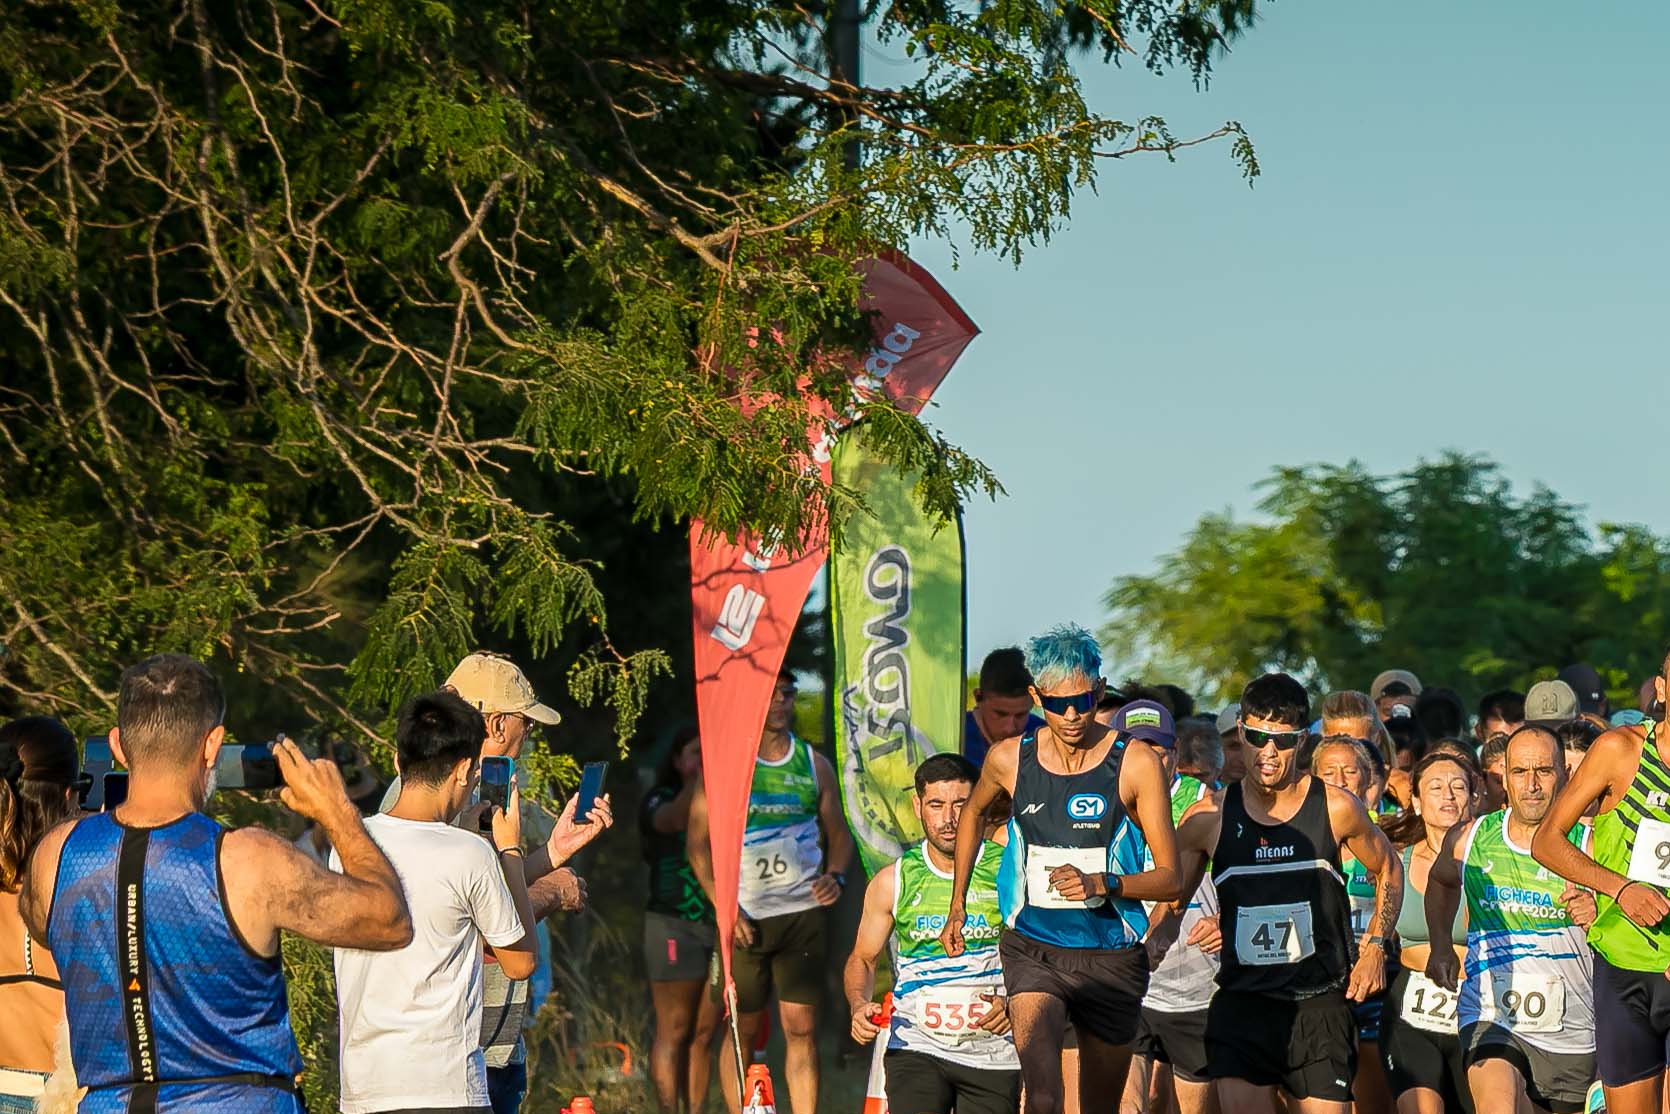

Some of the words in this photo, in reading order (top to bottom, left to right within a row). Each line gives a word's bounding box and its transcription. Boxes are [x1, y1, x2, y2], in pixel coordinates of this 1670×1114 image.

[756, 854, 787, 880] 26
[1251, 922, 1293, 951] 47
[924, 1002, 986, 1031] 535
[1501, 990, 1546, 1019] 90
